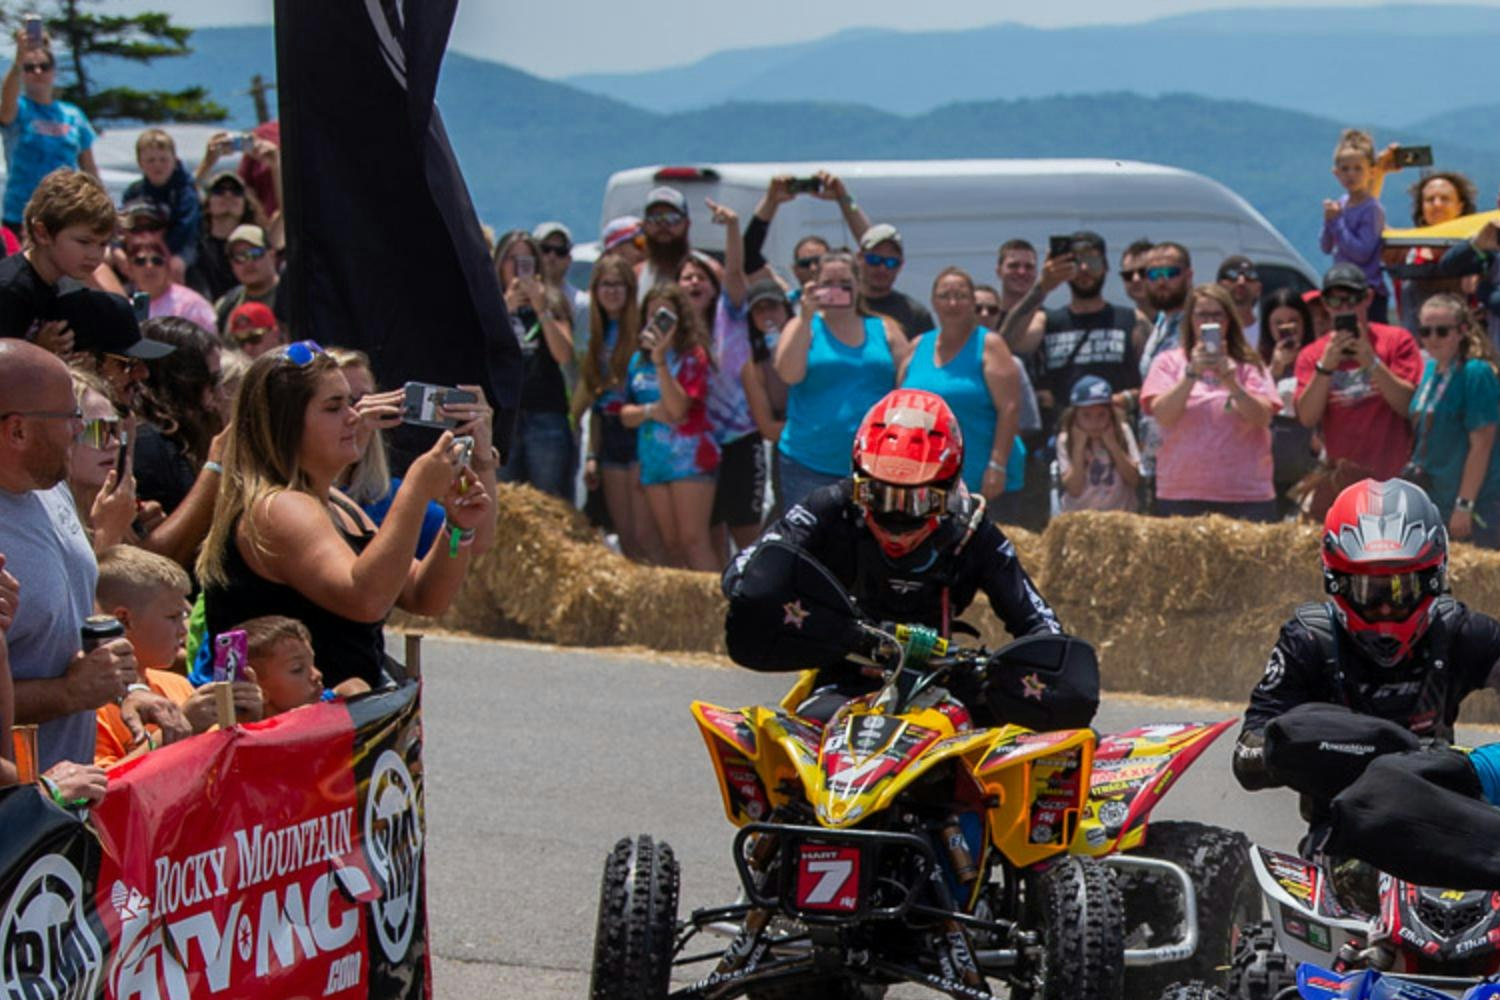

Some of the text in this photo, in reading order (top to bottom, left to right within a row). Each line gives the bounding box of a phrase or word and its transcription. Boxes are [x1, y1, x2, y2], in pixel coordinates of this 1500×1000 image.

[152, 807, 354, 920] ROCKY MOUNTAIN
[805, 860, 853, 904] 7
